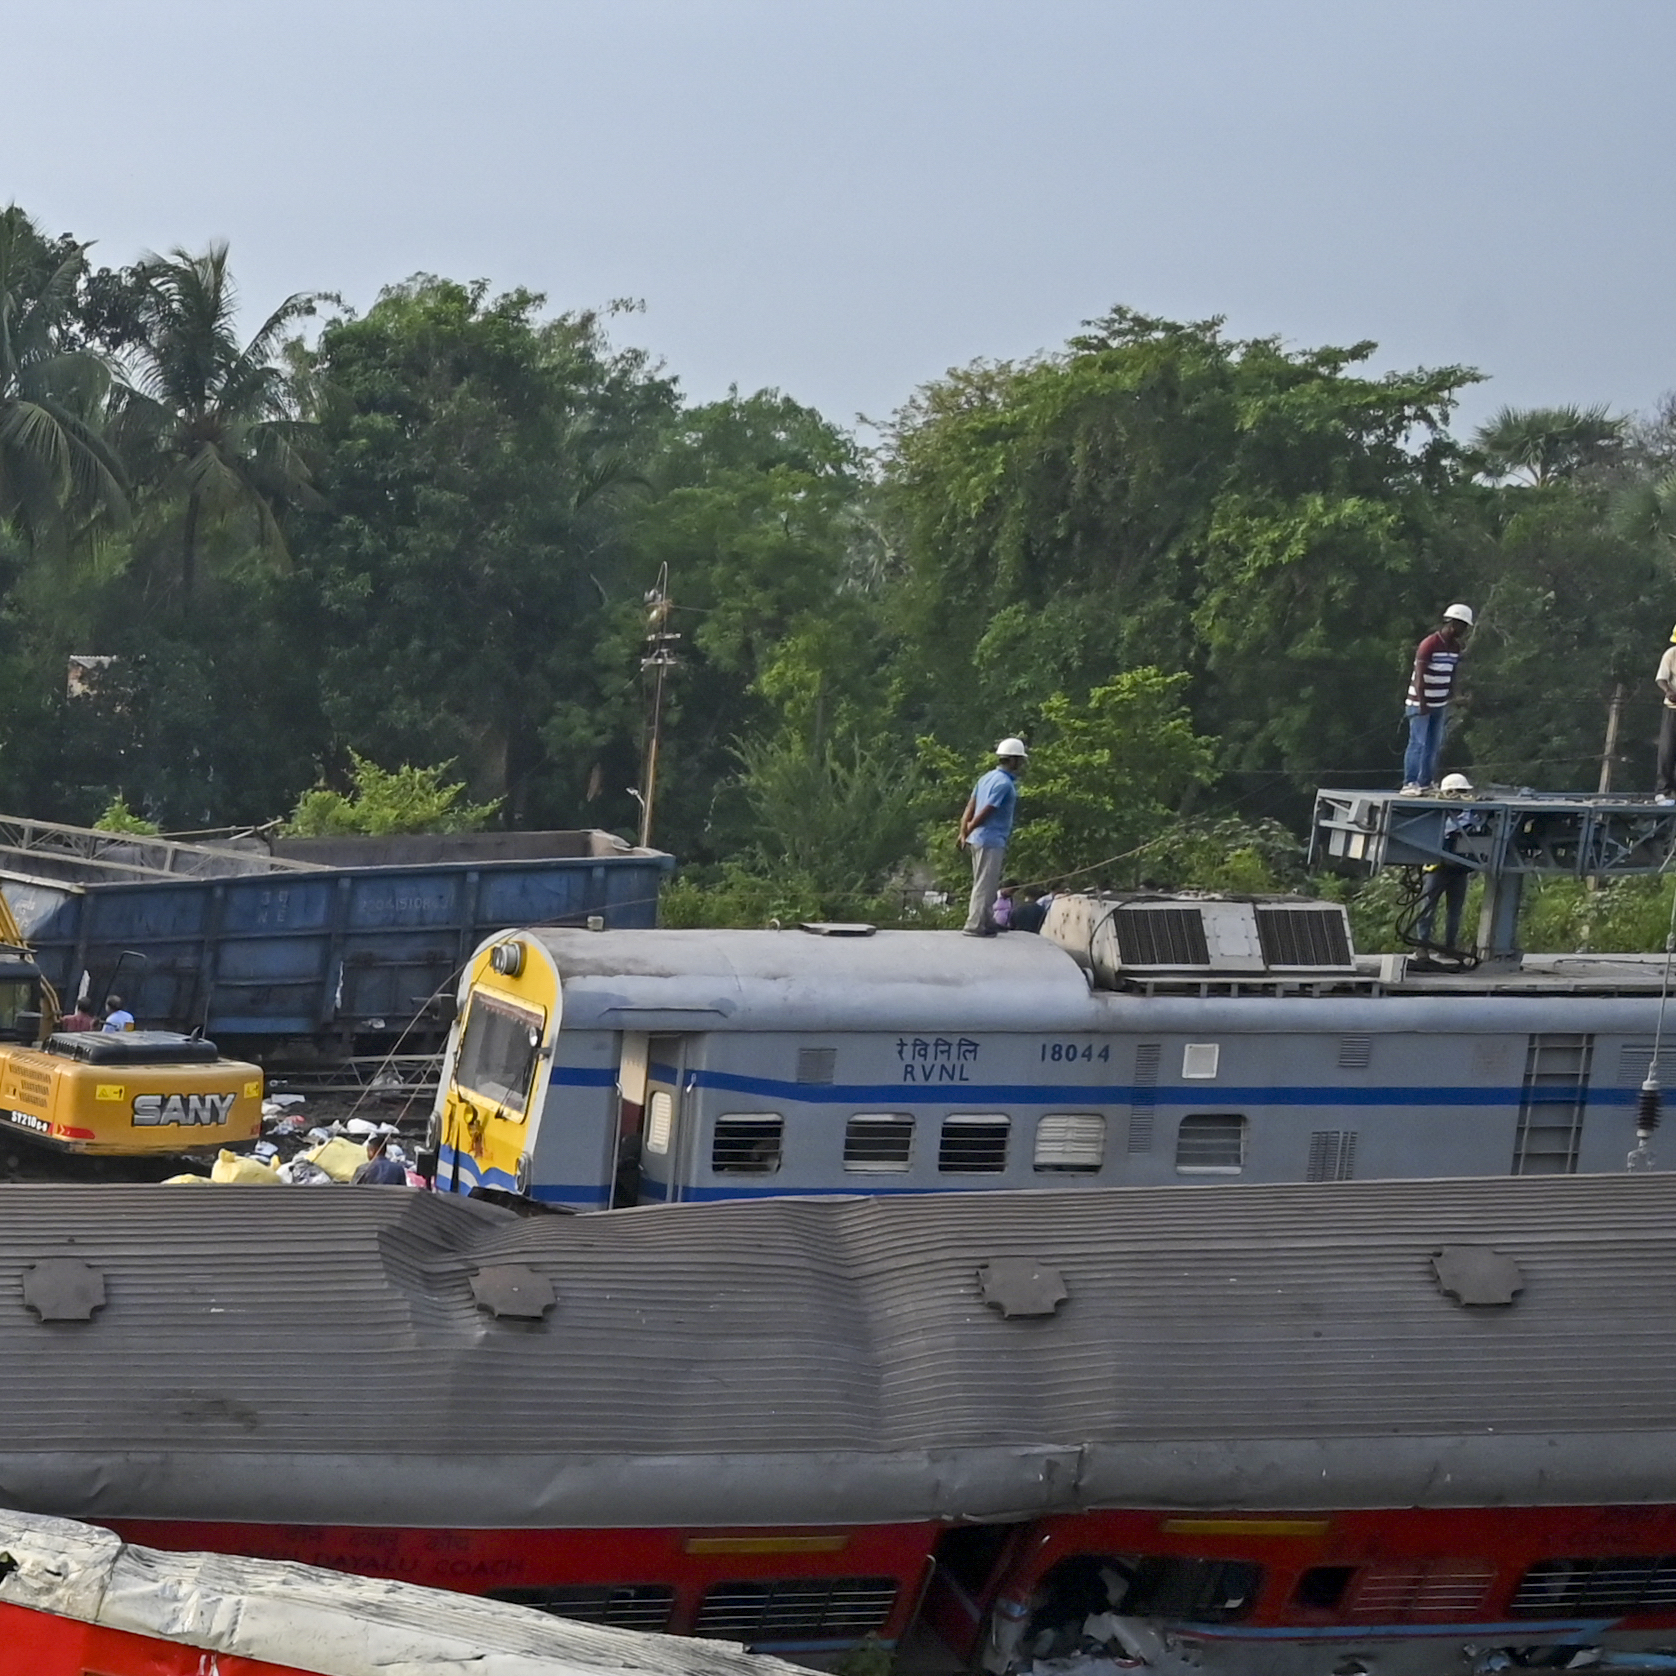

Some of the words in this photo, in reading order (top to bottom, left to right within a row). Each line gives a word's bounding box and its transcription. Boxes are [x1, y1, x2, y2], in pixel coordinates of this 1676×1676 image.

[1041, 1044, 1110, 1062] 18044
[903, 1063, 970, 1082] RVNL
[132, 1093, 237, 1126] SANY
[434, 1558, 525, 1577] COACH
